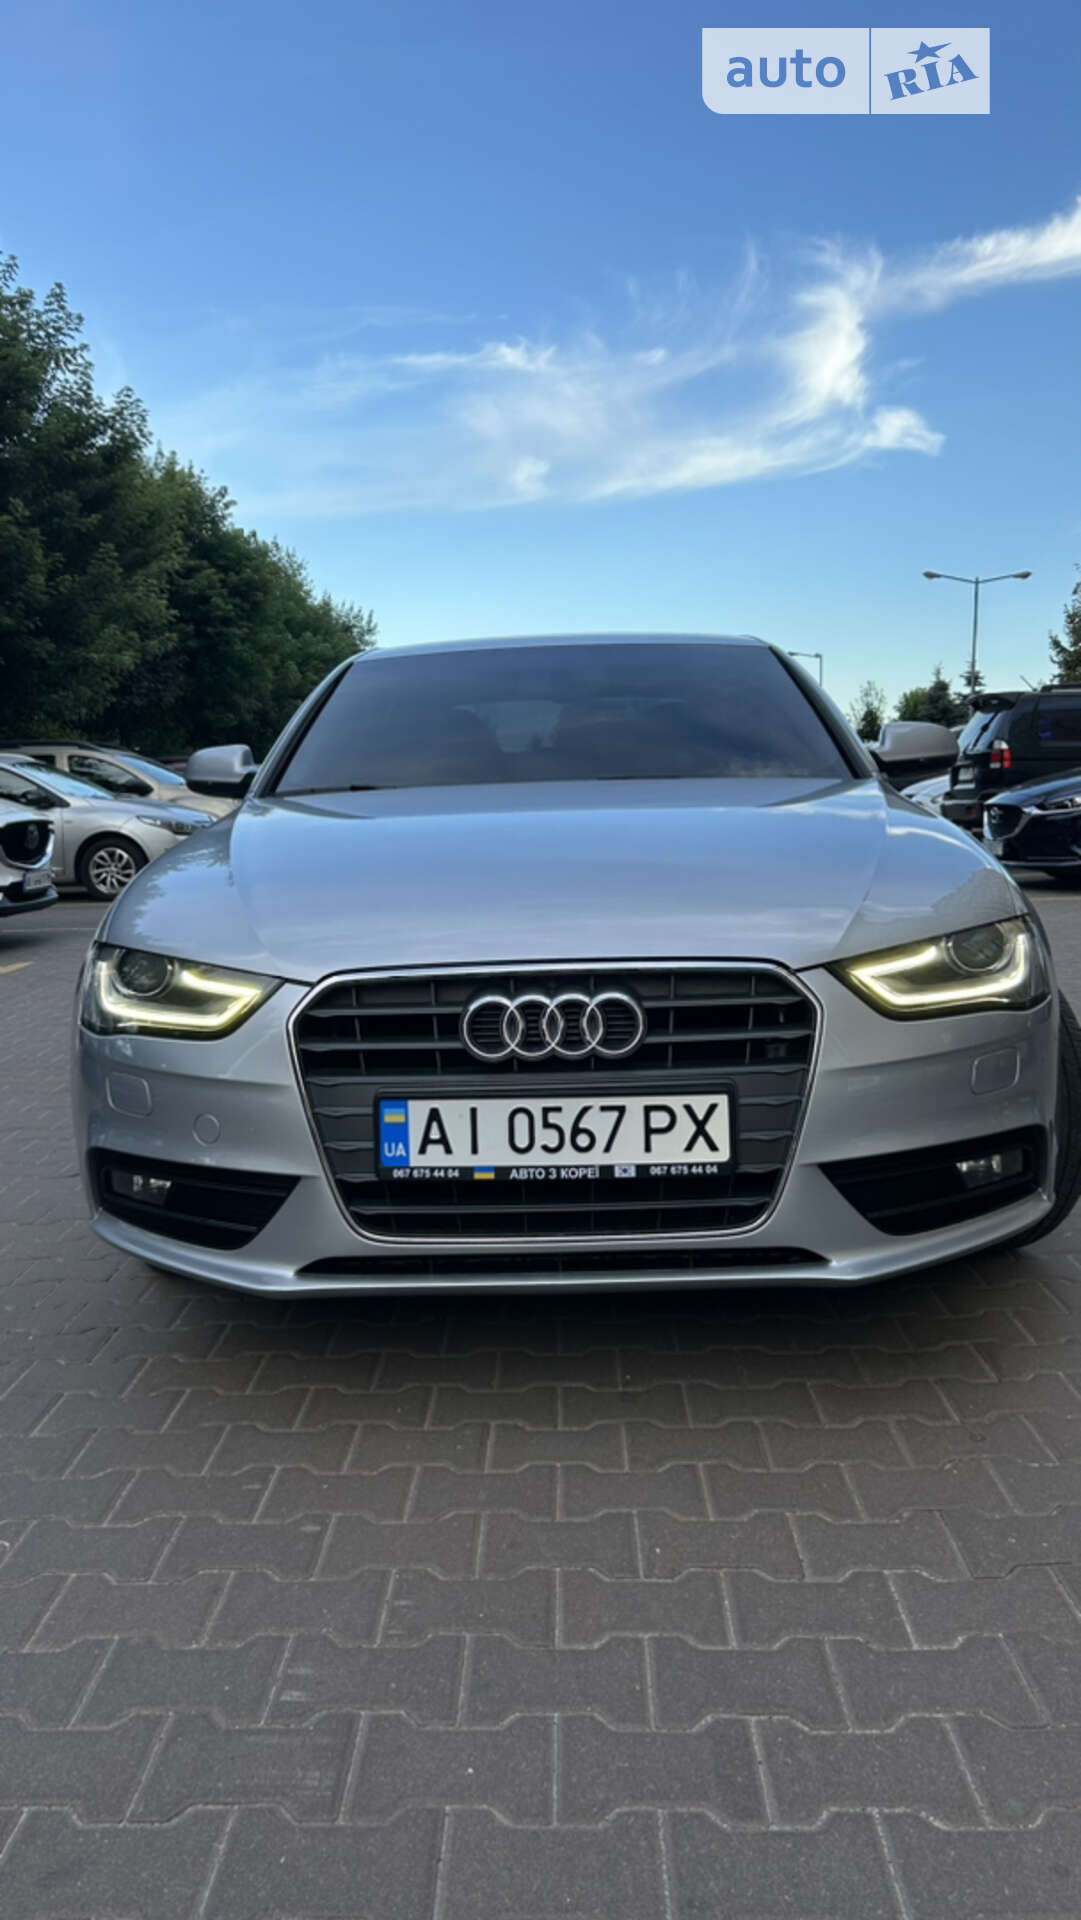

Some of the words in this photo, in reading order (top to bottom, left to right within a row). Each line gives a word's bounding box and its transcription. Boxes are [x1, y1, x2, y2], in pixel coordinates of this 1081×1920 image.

[418, 1107, 479, 1155] AI
[507, 1105, 627, 1155] 0567
[643, 1102, 720, 1153] PX
[384, 1142, 407, 1158] UA
[509, 1167, 546, 1180] АВТО
